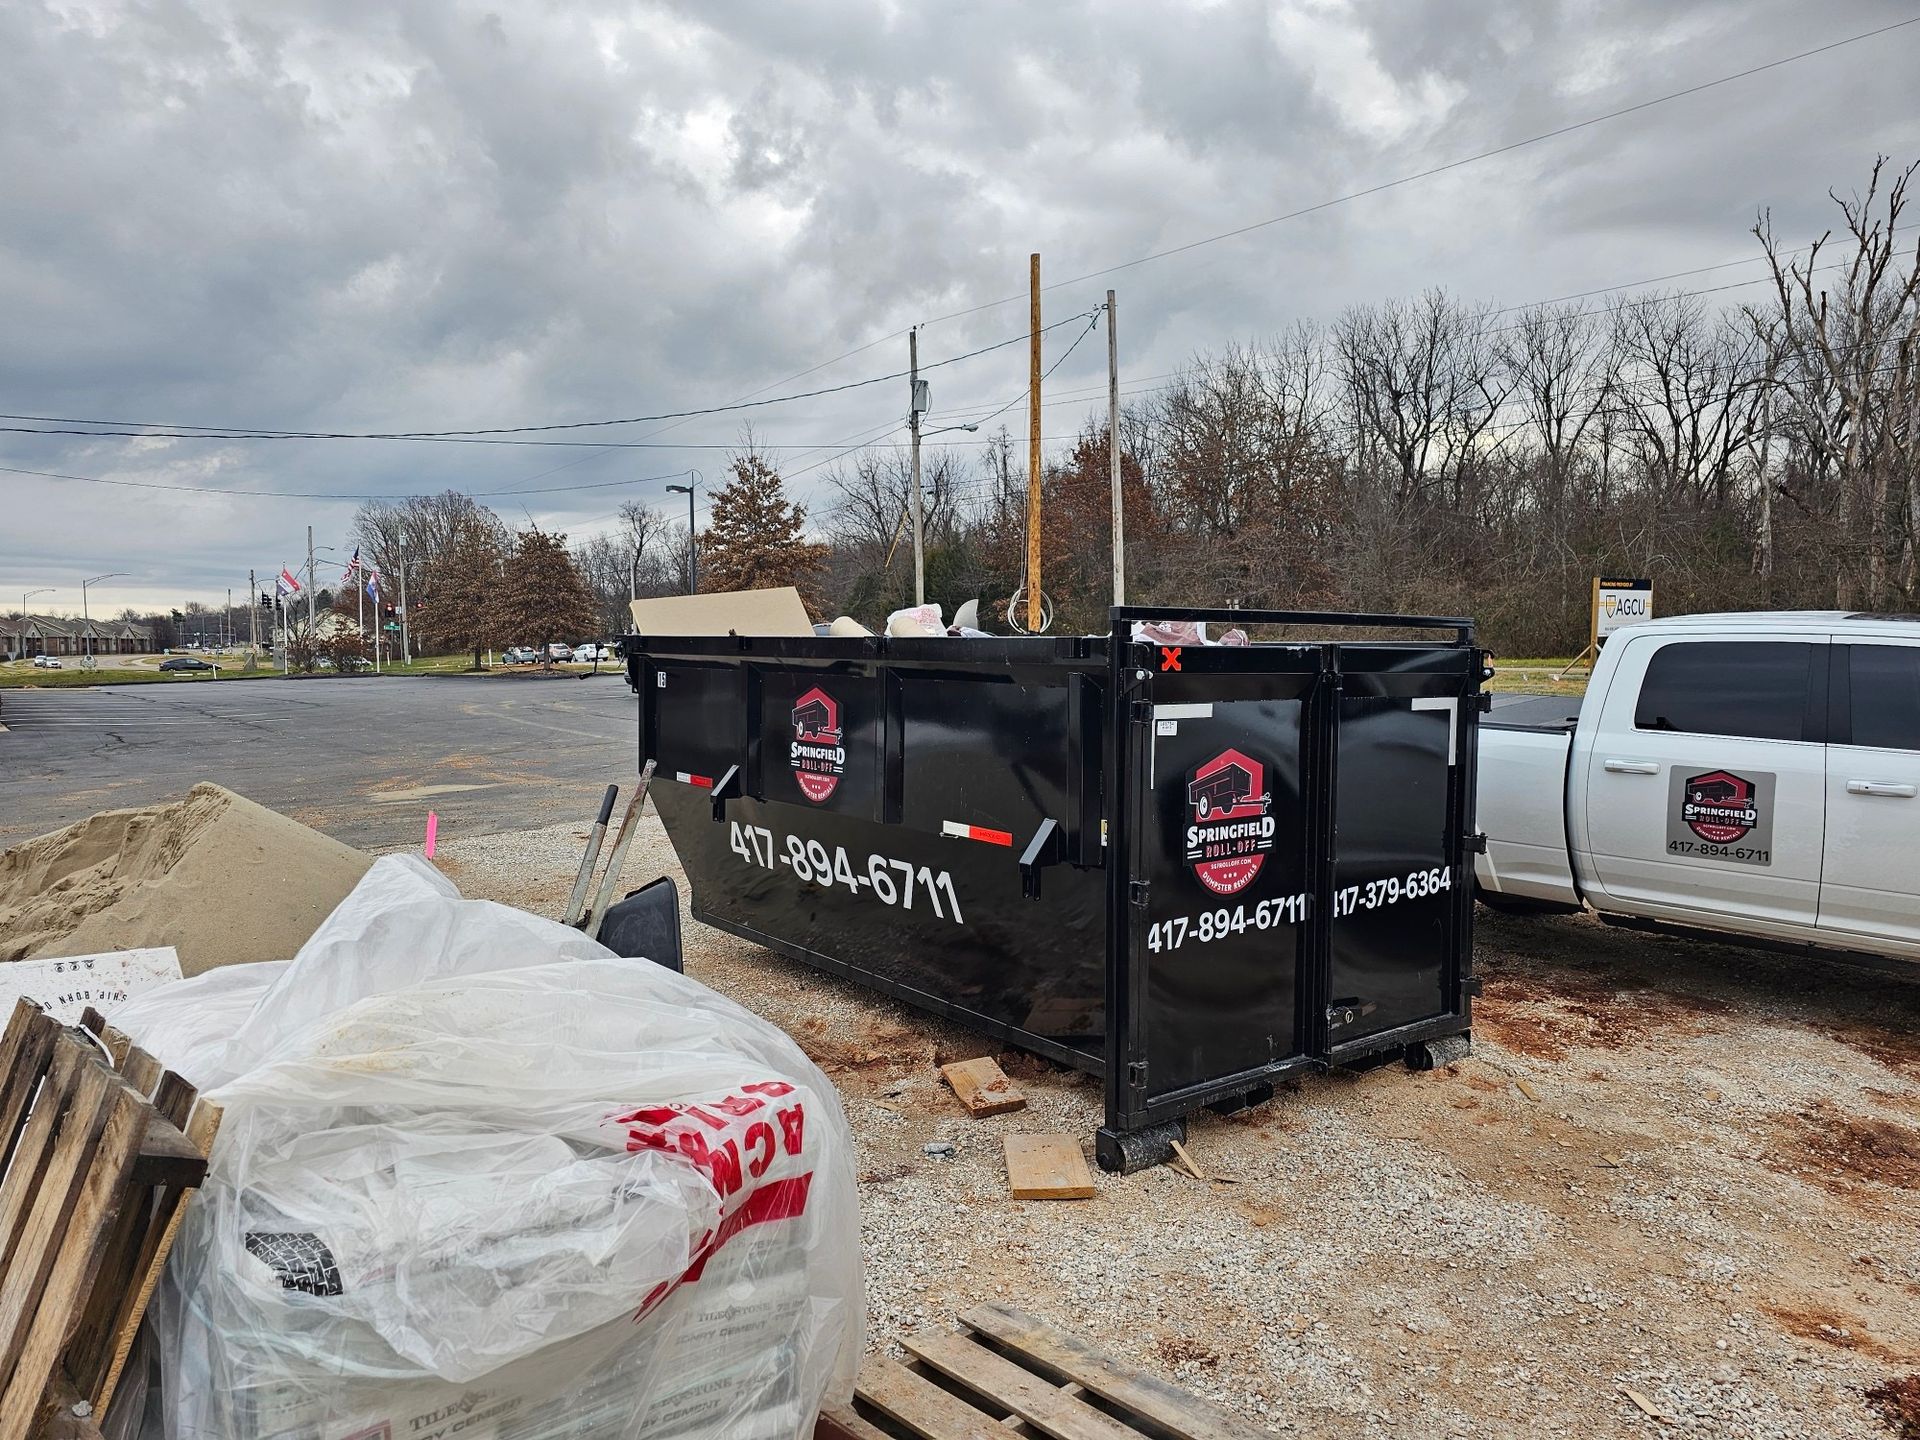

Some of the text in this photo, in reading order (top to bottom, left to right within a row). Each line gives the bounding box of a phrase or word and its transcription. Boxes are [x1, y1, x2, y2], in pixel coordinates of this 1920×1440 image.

[1615, 598, 1645, 615] AGCU
[791, 741, 845, 765] SPRINGFIELD
[802, 759, 832, 772] ROLL-OFF
[1685, 804, 1756, 820] SPRINGFIELD
[1187, 816, 1275, 849] SPRINGFIELD
[1206, 839, 1256, 858] ROLL-OFF
[1669, 840, 1769, 861] 417-894-6711
[730, 821, 963, 925] 417-894-6711
[1202, 864, 1257, 891] DUMPSTER RENTALS
[1148, 893, 1307, 953] 417-894-6711
[58, 990, 90, 1004] BORN
[719, 1321, 768, 1337] CEMENT
[662, 1399, 721, 1423] CEMENT
